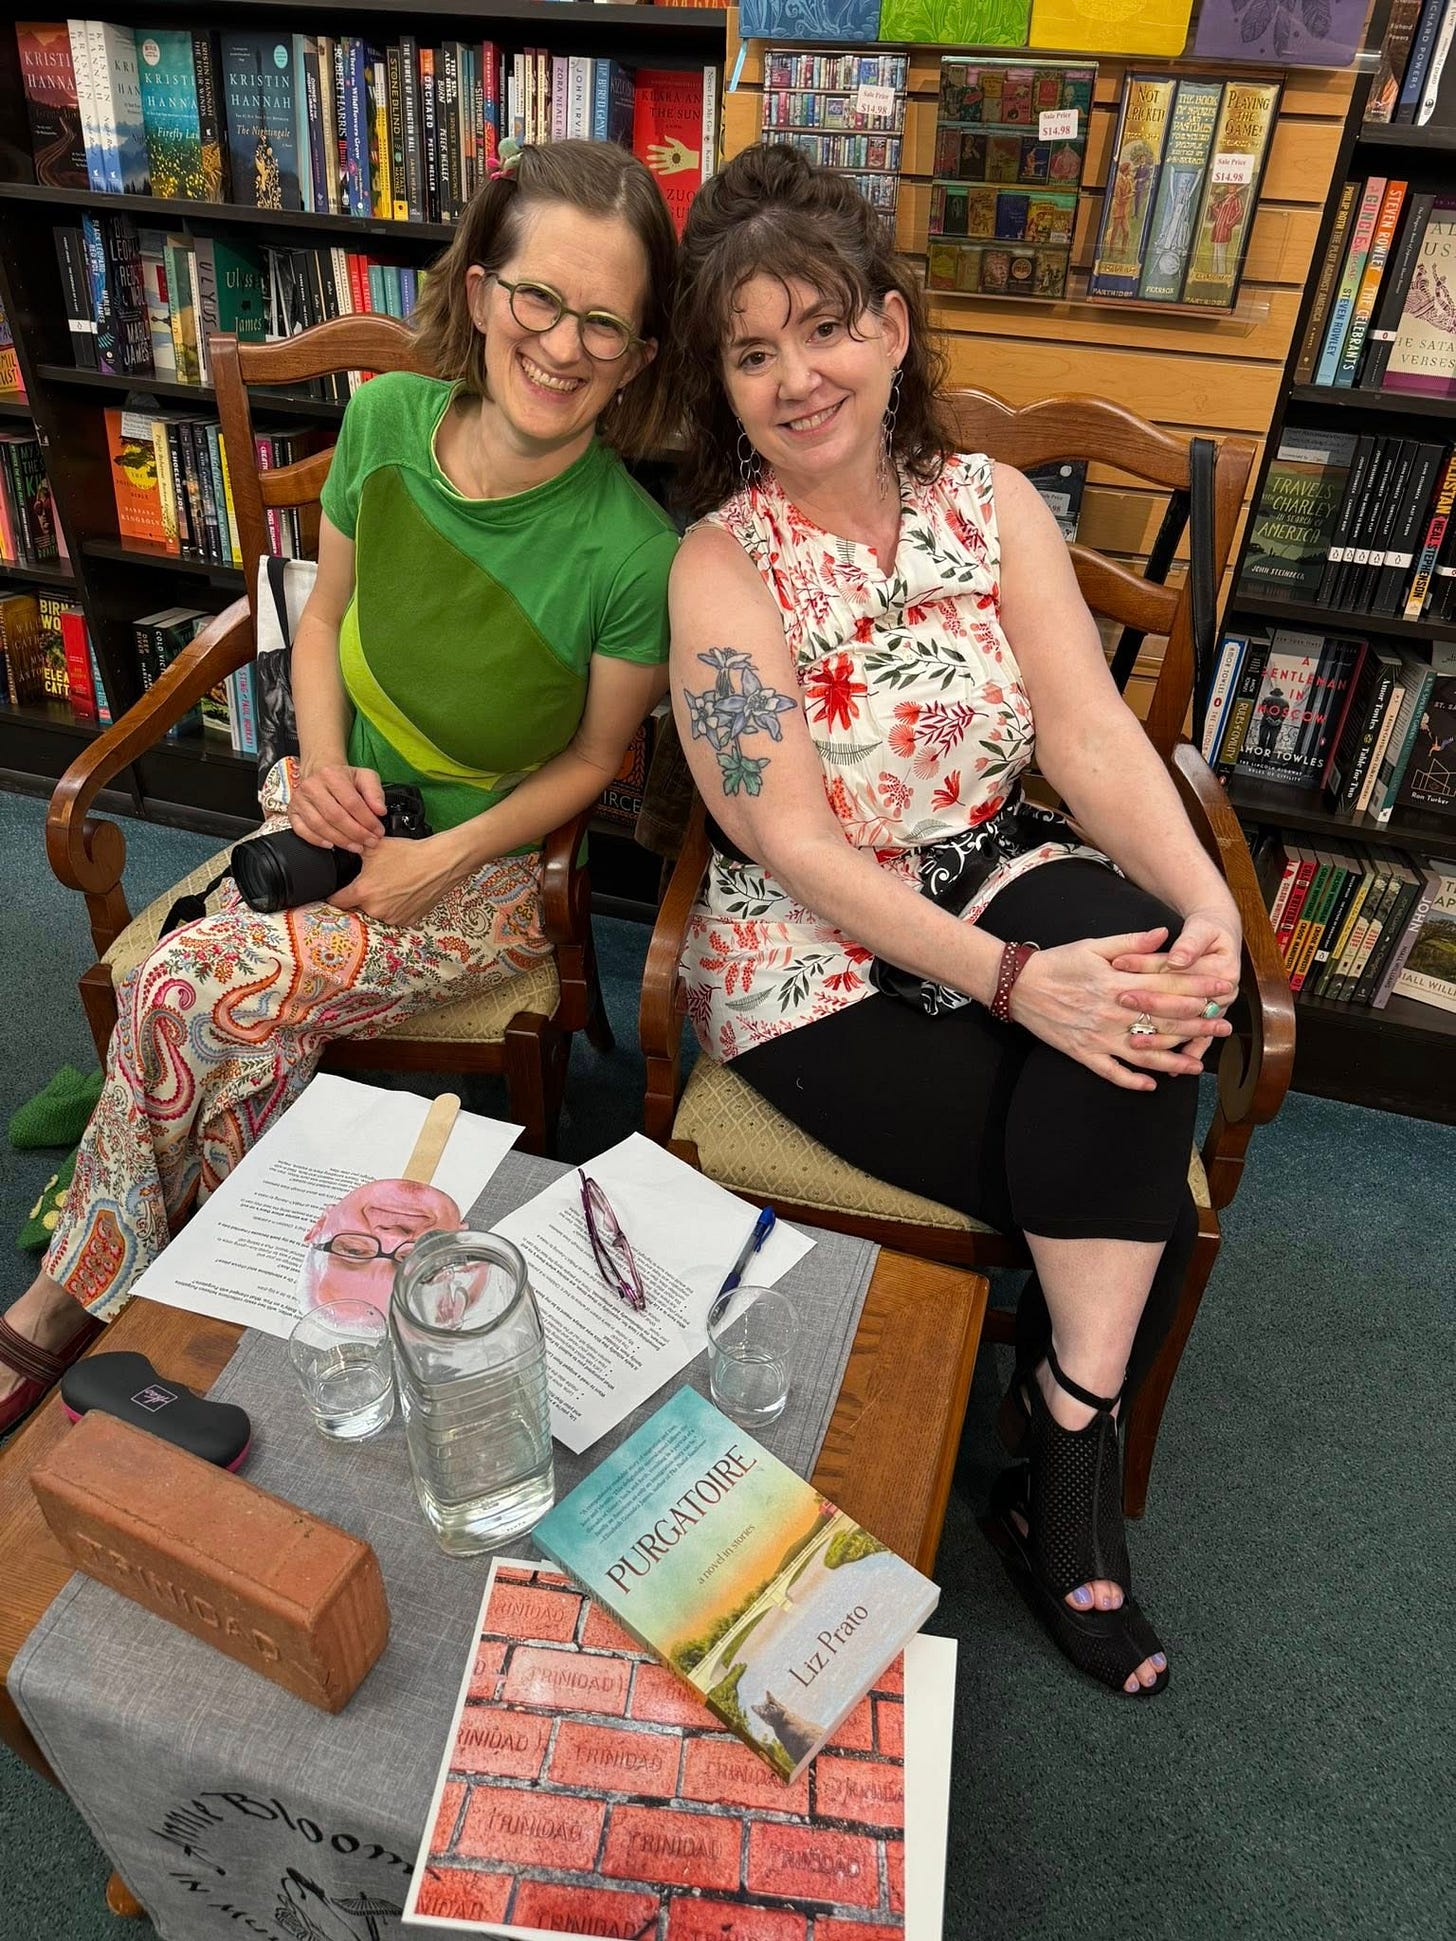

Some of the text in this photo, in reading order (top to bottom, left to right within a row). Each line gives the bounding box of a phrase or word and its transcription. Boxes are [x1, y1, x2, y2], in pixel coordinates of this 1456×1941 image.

[1390, 23, 1414, 31] Richard
[24, 51, 70, 68] KRISTI
[349, 49, 358, 76] Where
[1409, 46, 1427, 89] POWERS
[28, 73, 74, 90] HANNA
[144, 73, 195, 86] KRISTI
[196, 59, 204, 85] FOUR
[230, 73, 290, 88] KRISTIN
[556, 67, 564, 93] ZORA
[705, 70, 714, 92] Never
[334, 48, 348, 136] ROBERT HARRIS
[405, 86, 412, 94] OF
[575, 67, 583, 102] JOHN
[1138, 86, 1160, 102] NOT
[148, 96, 198, 108] HANNA
[231, 94, 292, 109] HANNAH
[390, 58, 401, 134] STONE BLIND
[424, 76, 434, 128] ORCHARD
[876, 92, 890, 100] Price
[1227, 90, 1270, 111] PLAYING
[351, 87, 361, 136] Wildflowers
[406, 96, 414, 134] ARLINGTON
[650, 108, 701, 120] THE SUN
[860, 104, 888, 115] $14.98
[1056, 111, 1071, 120] Price
[1237, 111, 1254, 122] THE
[157, 126, 182, 141] Firefly
[236, 124, 290, 138] The Nightingale
[705, 120, 713, 132] Go
[1042, 125, 1071, 136] $14.98
[1224, 119, 1263, 138] GAME!
[354, 138, 362, 159] Grow
[407, 136, 415, 152] HALL
[427, 139, 436, 191] PETER HELLER
[439, 129, 449, 182] PETER HELLER
[1217, 158, 1246, 167] Sale Price
[1214, 172, 1244, 182] $14.98
[88, 244, 96, 258] RED
[1311, 185, 1357, 323] PHILIP ROTH THE PLOT AGAINST AMERICA
[1341, 187, 1404, 373] STEVEN ROWLEY THE CELEBRANTS
[96, 301, 105, 324] JAMES
[102, 289, 111, 317] MARLON
[1324, 286, 1353, 358] STEVEN ROWLEY
[1400, 354, 1455, 368] VERSES
[1350, 456, 1366, 494] JOHN STEINBECK
[1366, 450, 1382, 488] JOHN STEINBECK
[1377, 459, 1393, 497] JOHN STEINBECK
[1392, 460, 1409, 500] JOHN STEINBECK
[170, 450, 185, 513] SHOELESS JOE
[1272, 476, 1334, 500] TRAVELS
[1414, 461, 1431, 500] JOHN STEINBECK
[1273, 497, 1337, 518] CHARLEY
[1257, 522, 1321, 544] AMERICA
[1411, 518, 1446, 600] NEAL STEPHENSON
[1251, 564, 1305, 580] JOHN STEINBECK
[156, 631, 164, 652] COLD
[1217, 646, 1236, 695] AMOR TOWLES
[1302, 656, 1310, 666] A
[44, 668, 70, 684] ELEA
[239, 672, 249, 694] STING
[1260, 666, 1348, 691] GENTLEMAN
[44, 680, 71, 696] CATT
[1289, 690, 1304, 700] IN
[1257, 703, 1328, 724] MOSCOW
[1368, 678, 1391, 732] Amor Towles
[1210, 711, 1219, 722] THE
[1225, 701, 1249, 759] RULES CIVILITY
[1276, 750, 1324, 768] TOWLES
[1346, 745, 1370, 800] Table for Two
[604, 790, 641, 814] IRCE
[1315, 867, 1330, 890] COLSON
[1330, 870, 1344, 893] COLSON
[1278, 881, 1291, 903] COLSON
[1408, 896, 1432, 933] JOHN
[1295, 921, 1308, 941] CROOK
[1309, 925, 1322, 945] CROOK
[604, 1444, 758, 1594] PURGATOIRE
[704, 1554, 726, 1580] novel
[732, 1524, 756, 1550] stories
[76, 1530, 281, 1662] TRINIDAD
[788, 1604, 868, 1688] Liz Prato
[574, 1746, 662, 1772] TRINIDAD
[628, 1830, 722, 1860] TRINIDAD
